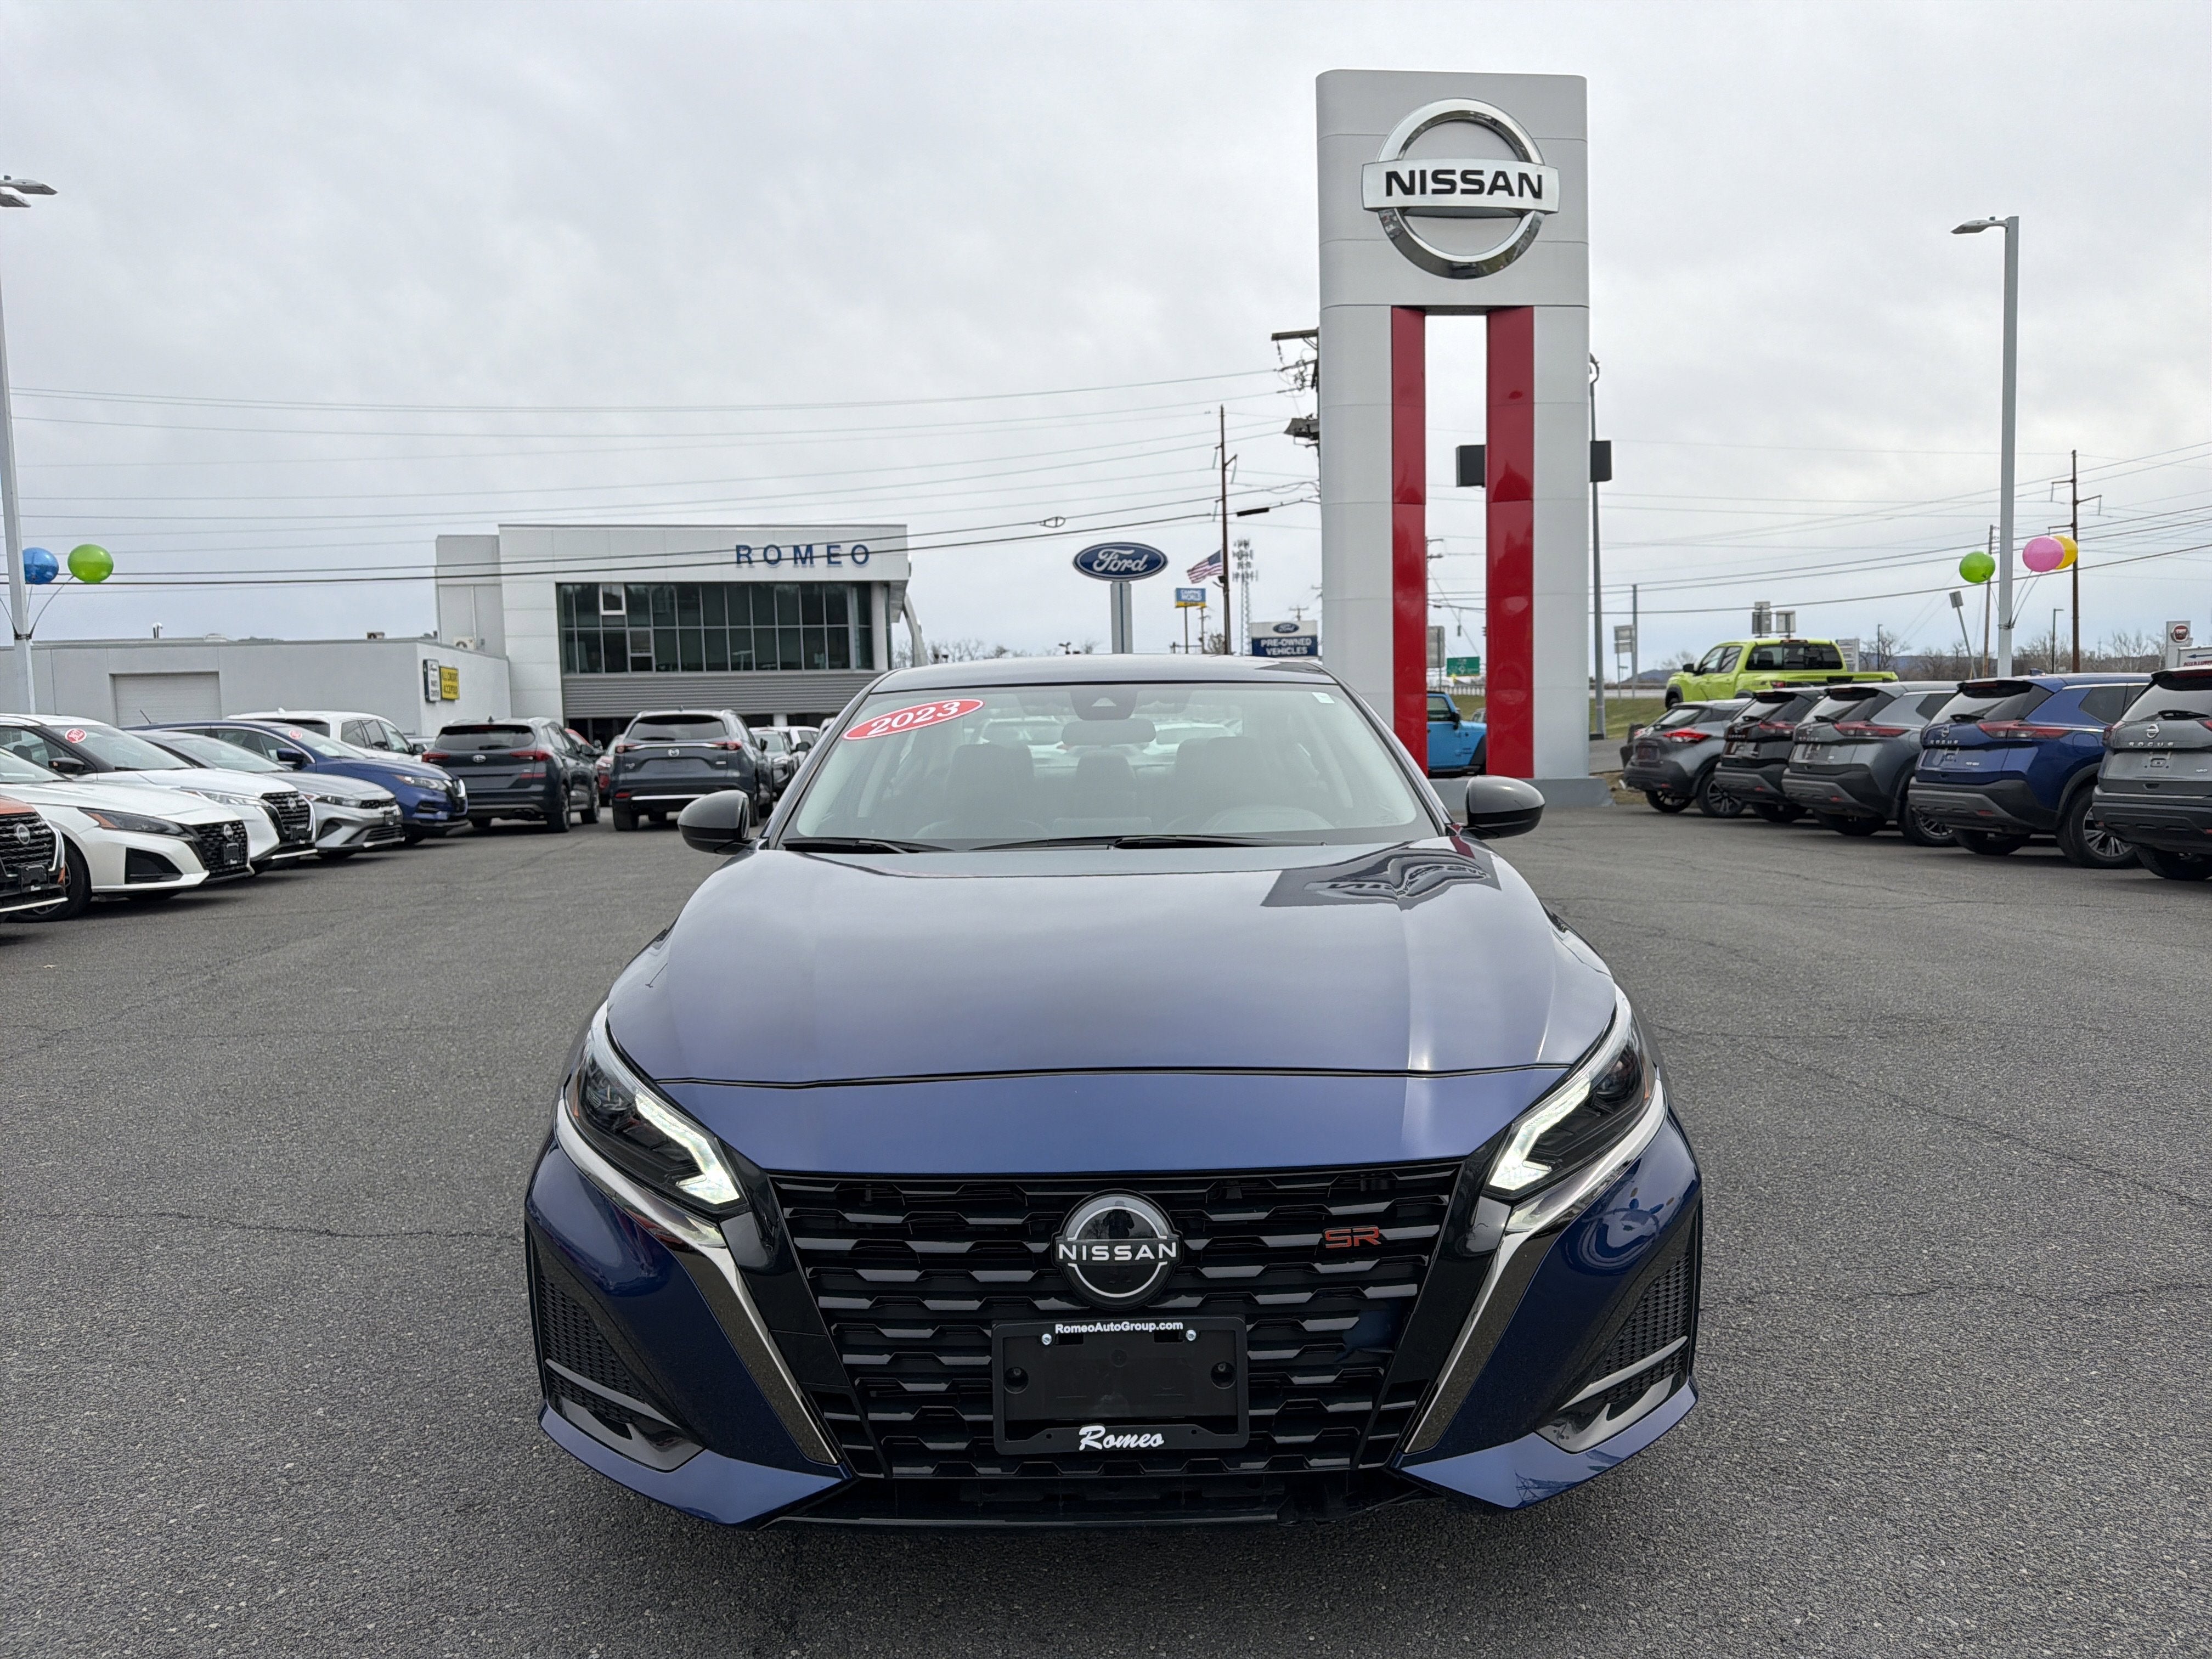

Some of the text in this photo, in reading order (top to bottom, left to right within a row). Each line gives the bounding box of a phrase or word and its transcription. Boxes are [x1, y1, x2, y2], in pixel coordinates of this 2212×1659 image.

[1385, 169, 1543, 199] NISSAN
[736, 544, 870, 565] ROMEO
[1092, 548, 1149, 572] Ford
[1260, 637, 1312, 647] PRE-OWNED
[1266, 647, 1308, 656] VEHICLES
[867, 702, 961, 736] 2023
[1324, 1226, 1382, 1249] SR
[1059, 1242, 1177, 1261] NISSAN
[1055, 1321, 1184, 1334] RomeoAutoGroup.com
[1079, 1425, 1165, 1451] Romeo
